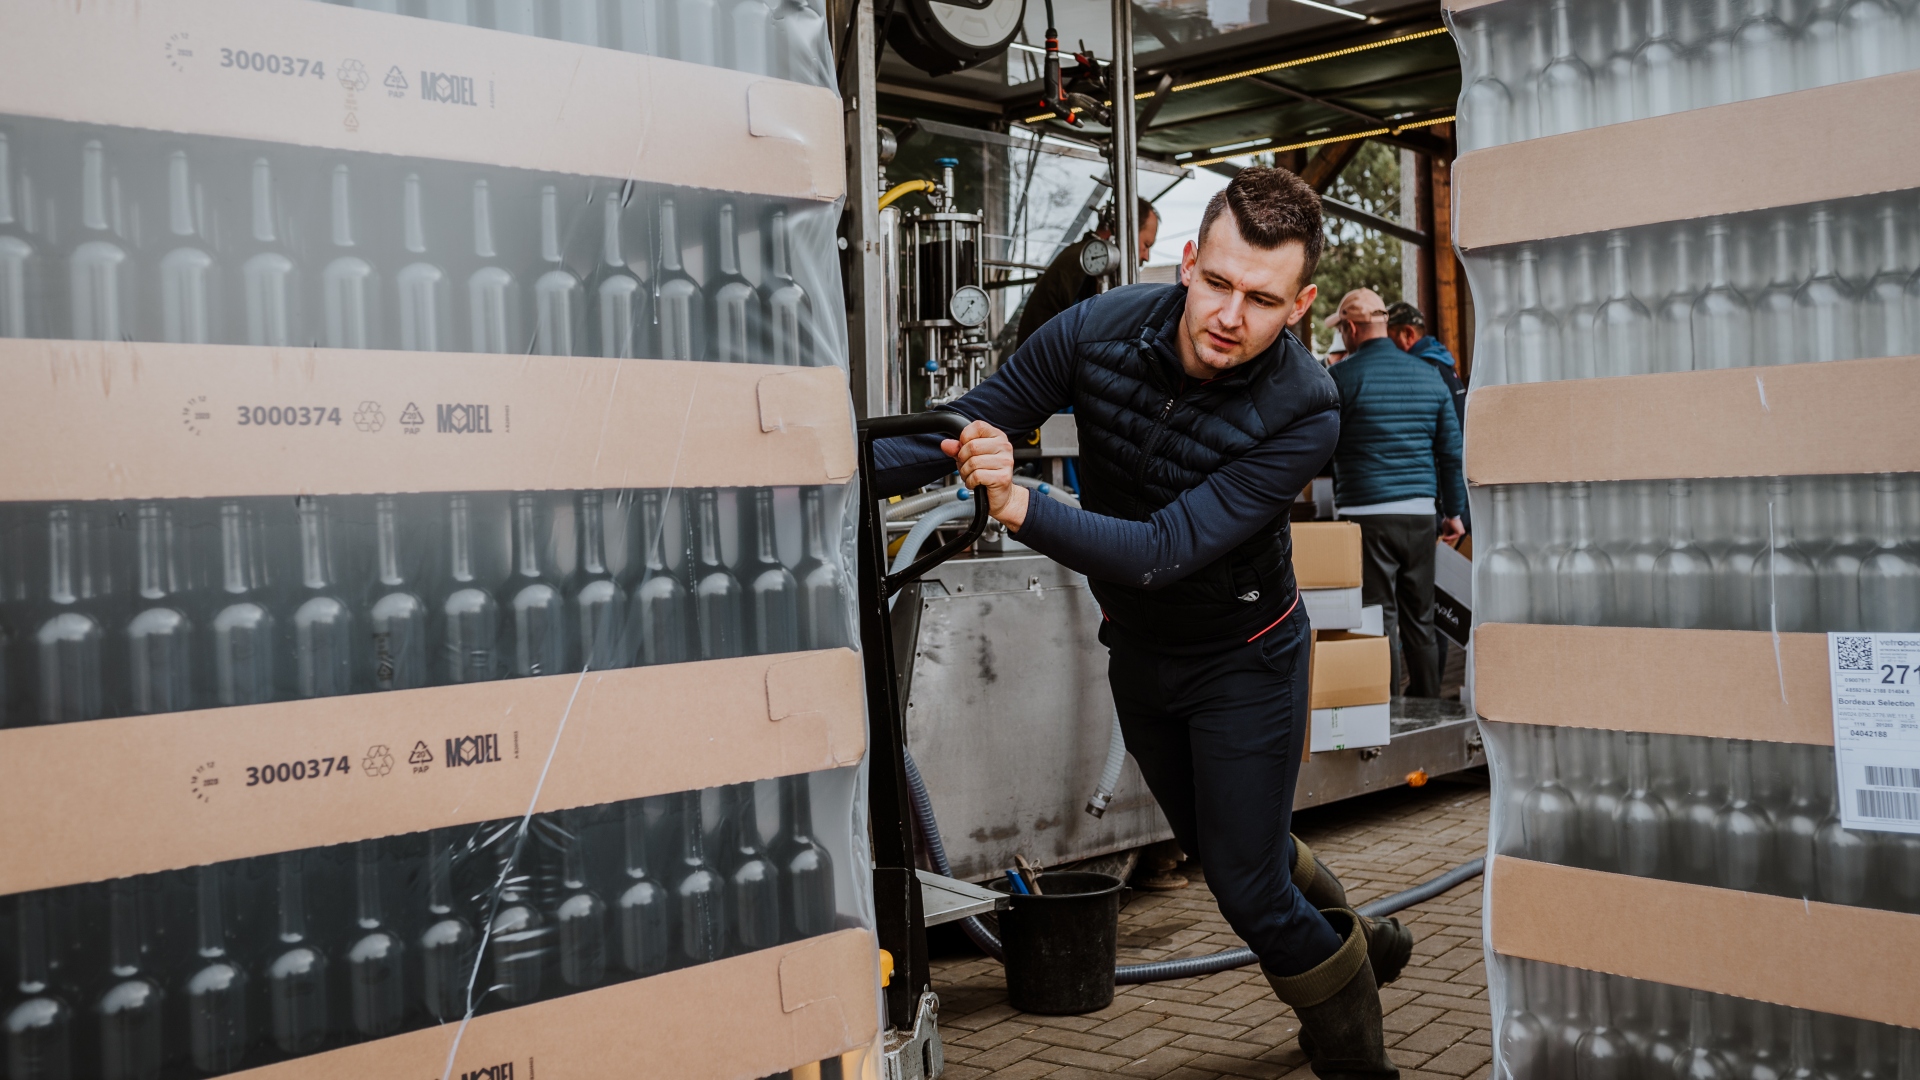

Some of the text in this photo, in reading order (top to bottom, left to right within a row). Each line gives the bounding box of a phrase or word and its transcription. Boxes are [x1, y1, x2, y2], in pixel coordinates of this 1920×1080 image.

[220, 47, 326, 80] 3000374
[388, 89, 405, 99] PAP
[421, 70, 478, 107] MODEL
[236, 405, 342, 427] 3000374
[436, 402, 493, 434] MODEL
[403, 427, 420, 435] PAP
[1838, 697, 1915, 707] Bordeaux Selection
[1850, 729, 1888, 738] 04042188
[445, 733, 502, 768] MODEL
[245, 755, 350, 787] 3000374
[413, 765, 430, 775] PAP
[461, 1061, 514, 1080] DEL
